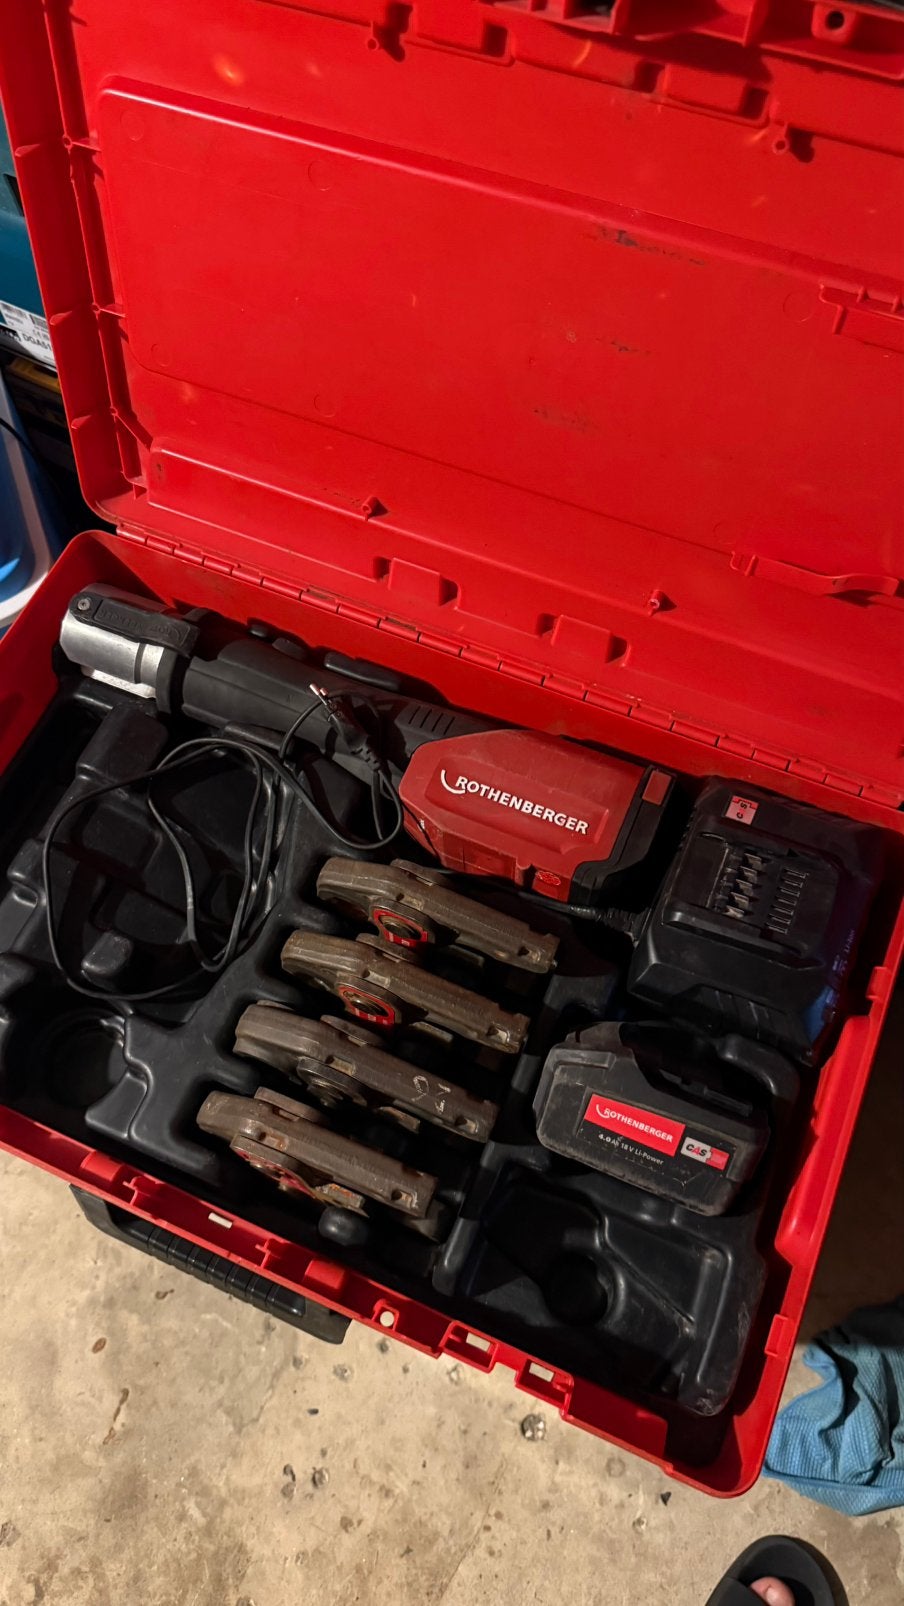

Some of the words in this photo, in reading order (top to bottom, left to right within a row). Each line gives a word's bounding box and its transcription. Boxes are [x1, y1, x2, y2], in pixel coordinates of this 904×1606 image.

[441, 770, 589, 835] ROTHENBERGER
[596, 1104, 673, 1142] ROTHENBERGER
[598, 1133, 611, 1143] 4.0
[635, 1149, 664, 1166] Li-Power
[685, 1143, 707, 1157] CAS
